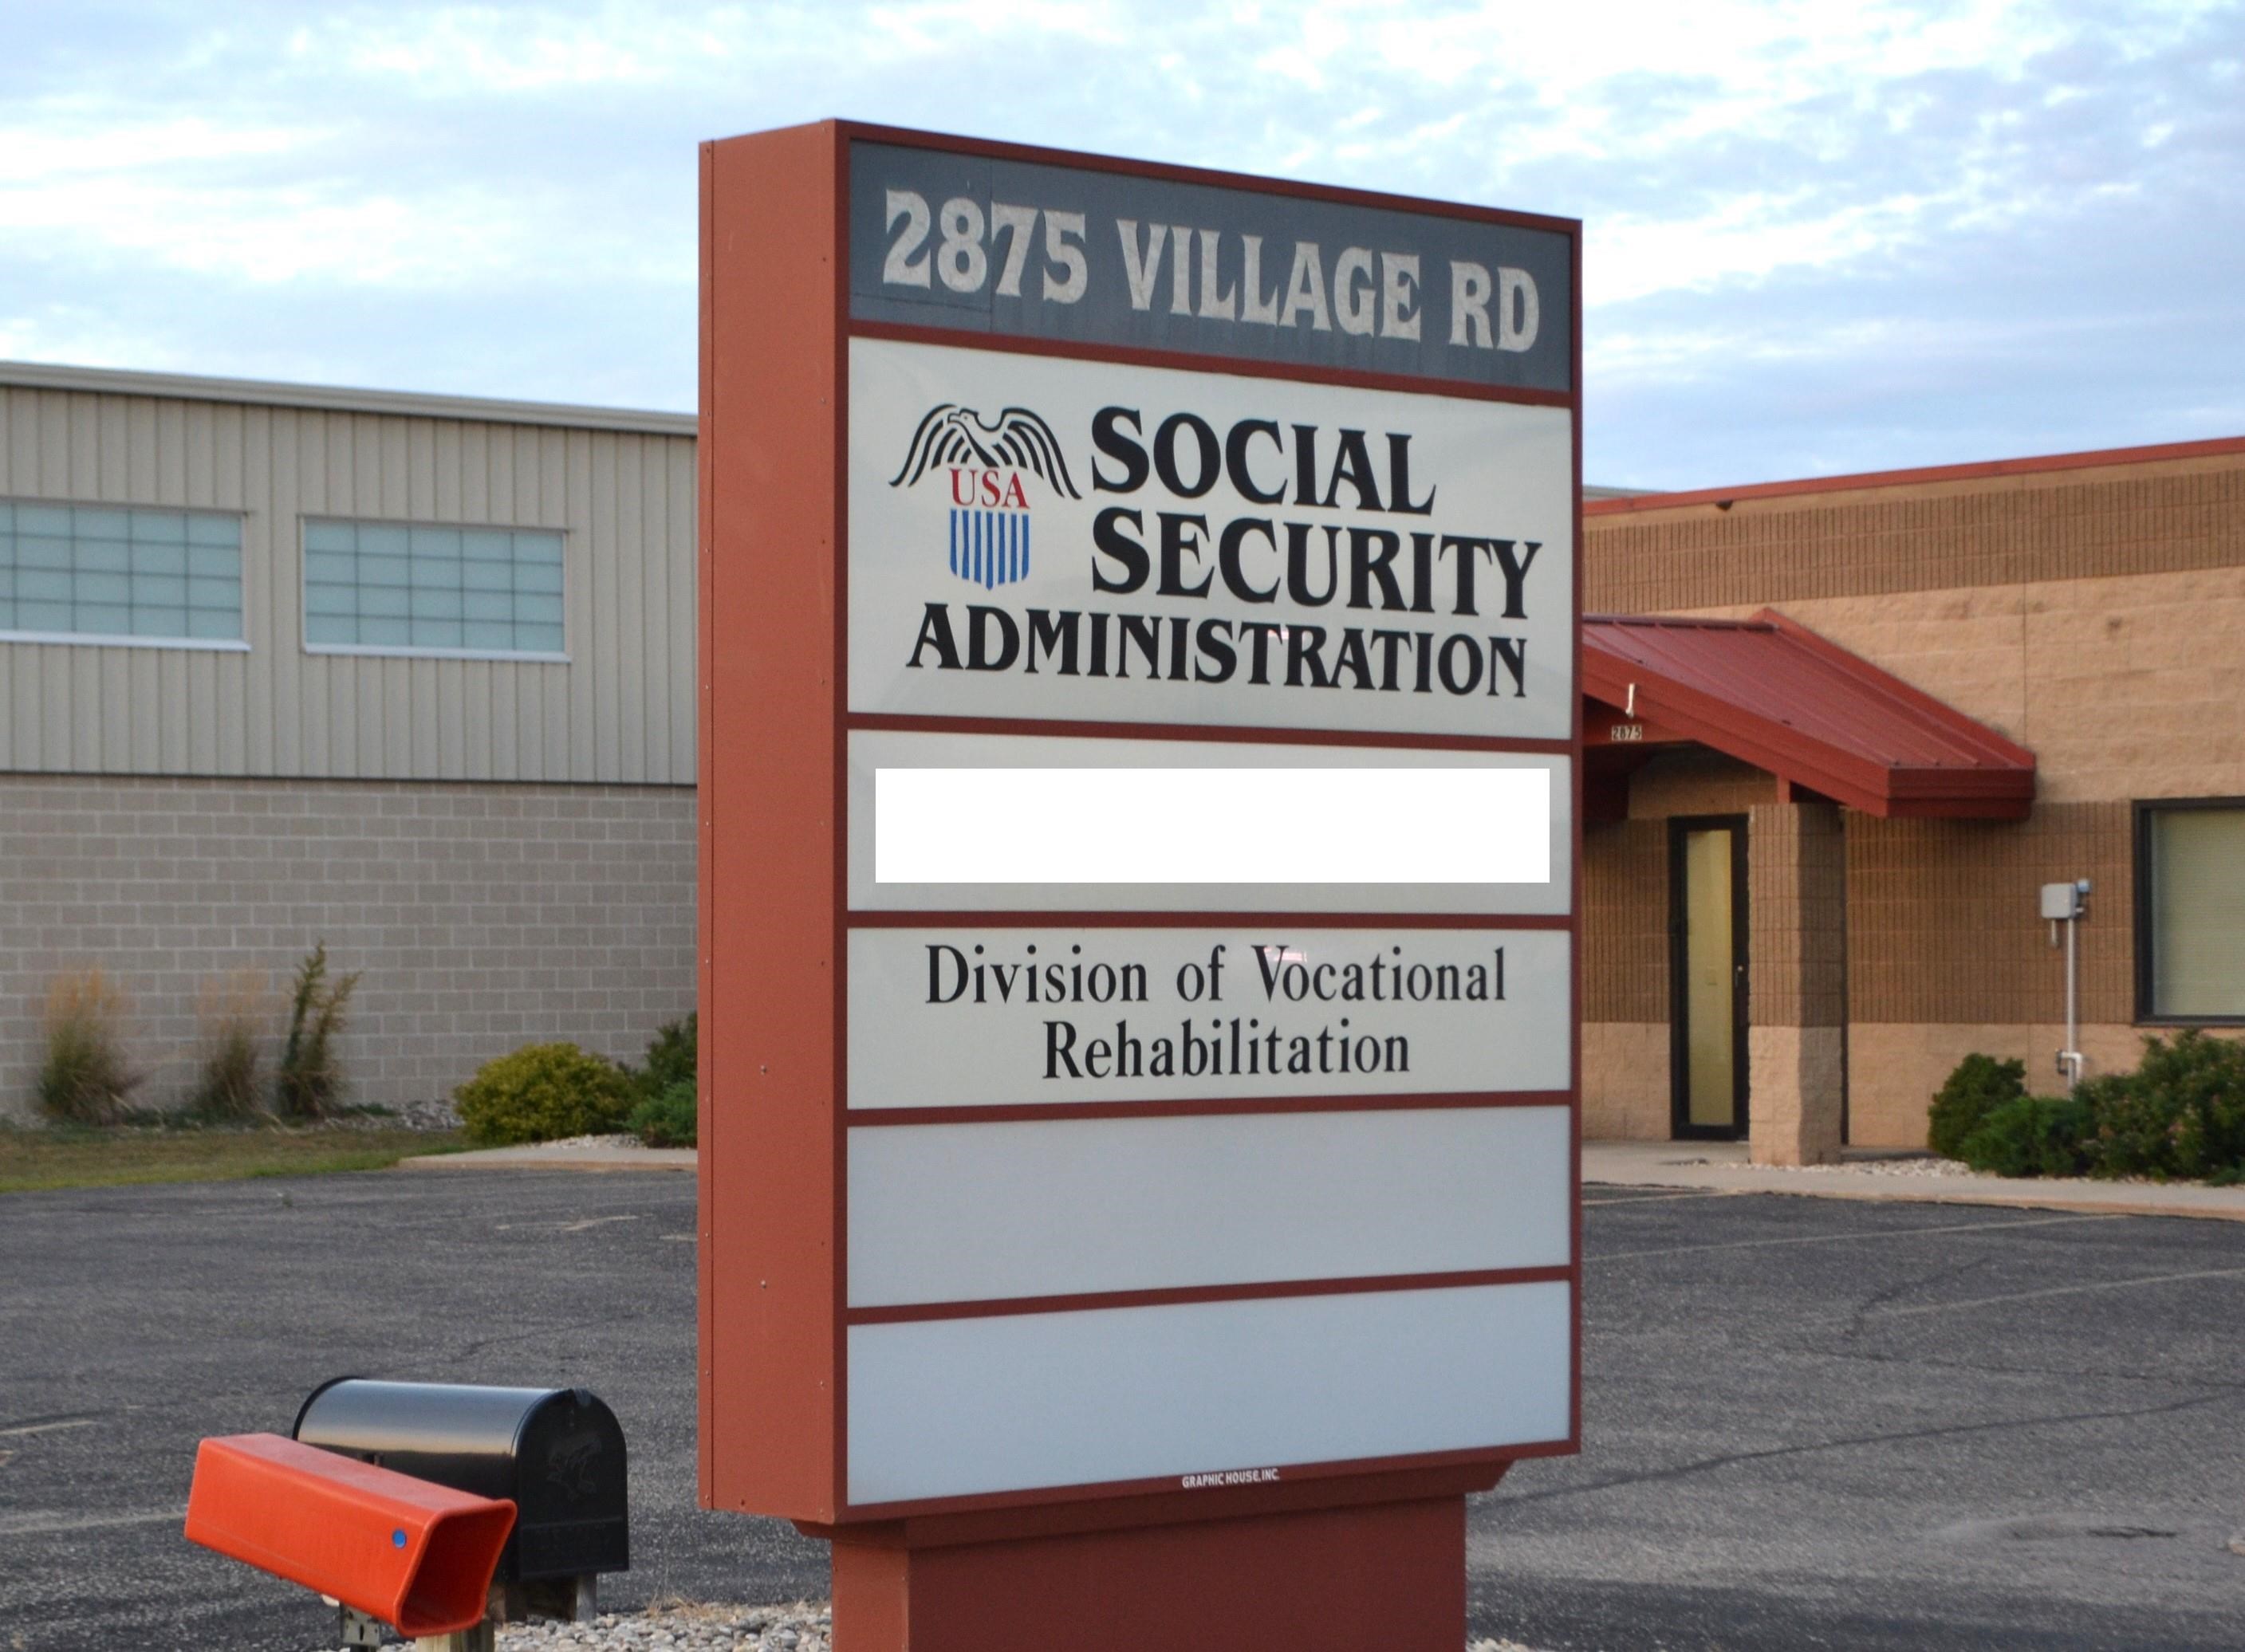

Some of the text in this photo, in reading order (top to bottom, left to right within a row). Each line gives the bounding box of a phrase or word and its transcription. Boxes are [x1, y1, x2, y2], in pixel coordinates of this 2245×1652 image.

[882, 189, 1540, 352] 2875 VILLAGE RD
[950, 469, 1030, 509] USA
[1091, 406, 1436, 516] SOCIAL
[1092, 508, 1542, 619] SECURITY
[906, 603, 1527, 698] ADMINISTRATION
[925, 944, 1507, 1003] Division of Vocational
[1042, 1017, 1410, 1079] Rehabilitation
[1182, 1473, 1224, 1489] GRAPHIC
